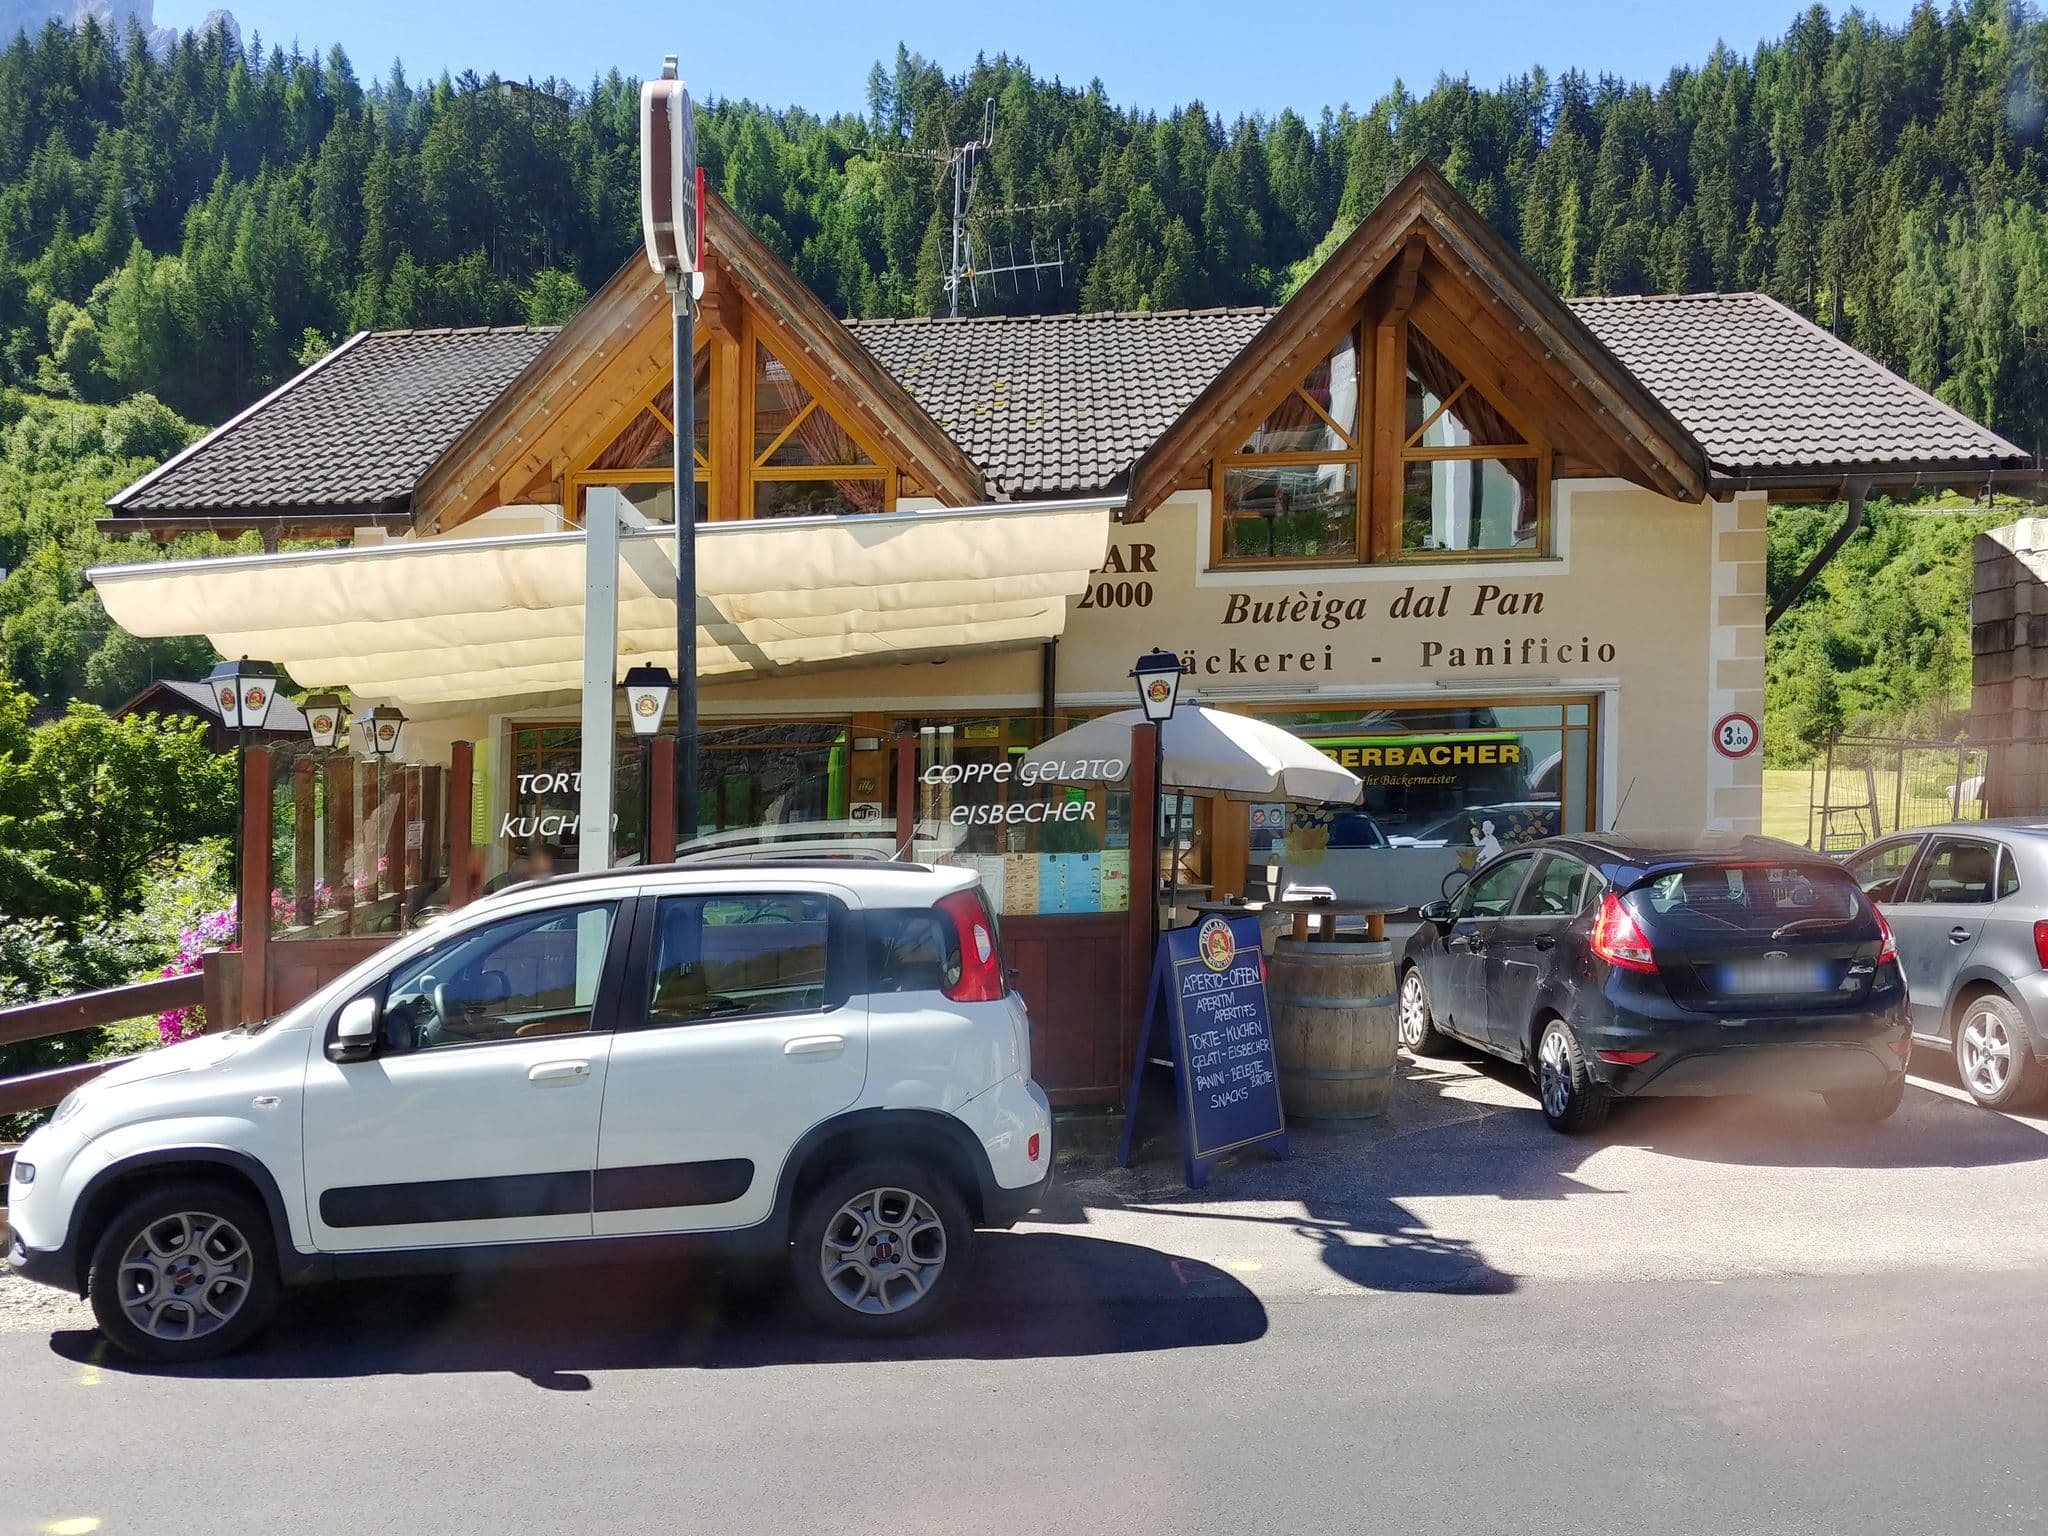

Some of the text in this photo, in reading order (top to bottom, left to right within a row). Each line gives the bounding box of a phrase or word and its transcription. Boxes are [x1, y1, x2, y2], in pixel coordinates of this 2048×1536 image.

[1100, 543, 1158, 574] AR
[1077, 581, 1153, 608] 2000
[1221, 585, 1544, 630] Butèiga dal Pan
[1181, 645, 1333, 675] äckerei
[1420, 637, 1615, 667] Panificio
[1322, 745, 1520, 767] BERBACHER
[517, 772, 581, 794] TORT
[1379, 774, 1457, 788] Bäckermeister
[499, 812, 618, 838] KUCH
[1210, 1086, 1249, 1109] SNACKS
